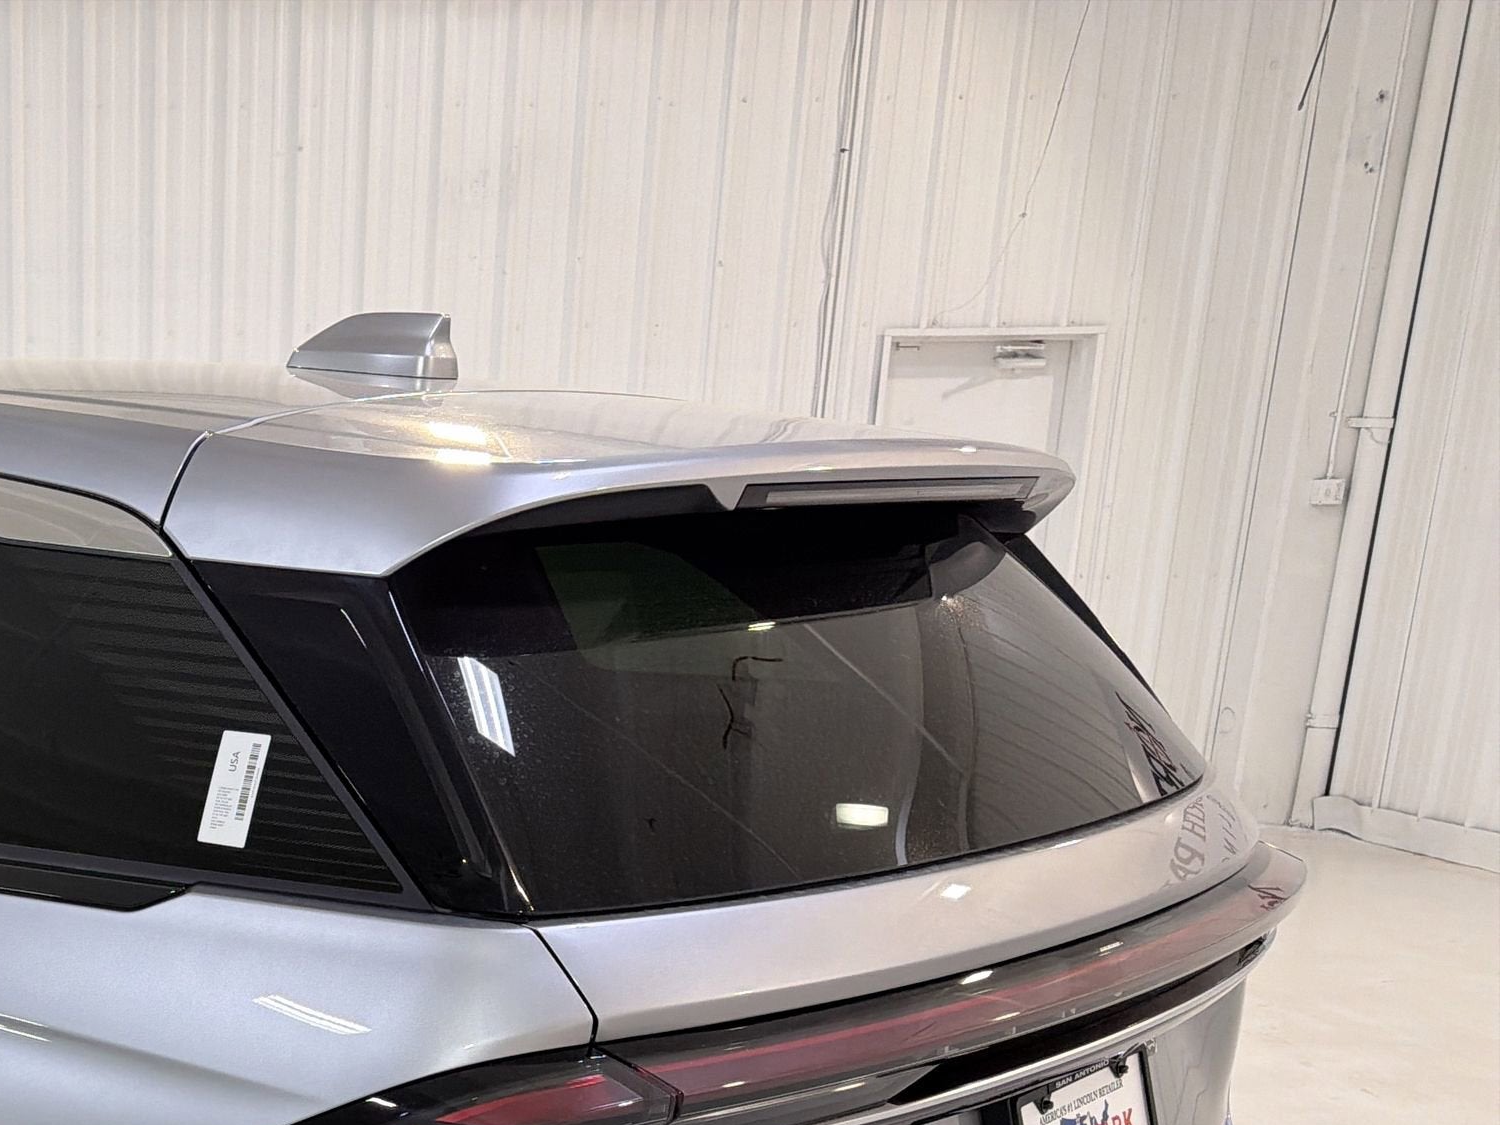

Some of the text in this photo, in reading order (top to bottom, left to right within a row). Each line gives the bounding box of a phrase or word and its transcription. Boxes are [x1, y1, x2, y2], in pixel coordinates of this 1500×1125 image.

[228, 751, 241, 772] USA
[1055, 1060, 1109, 1089] SAN ANTONIO
[1067, 1103, 1073, 1112] #1
[1074, 1090, 1098, 1110] LINCOLN
[1099, 1079, 1124, 1099] RETAILER
